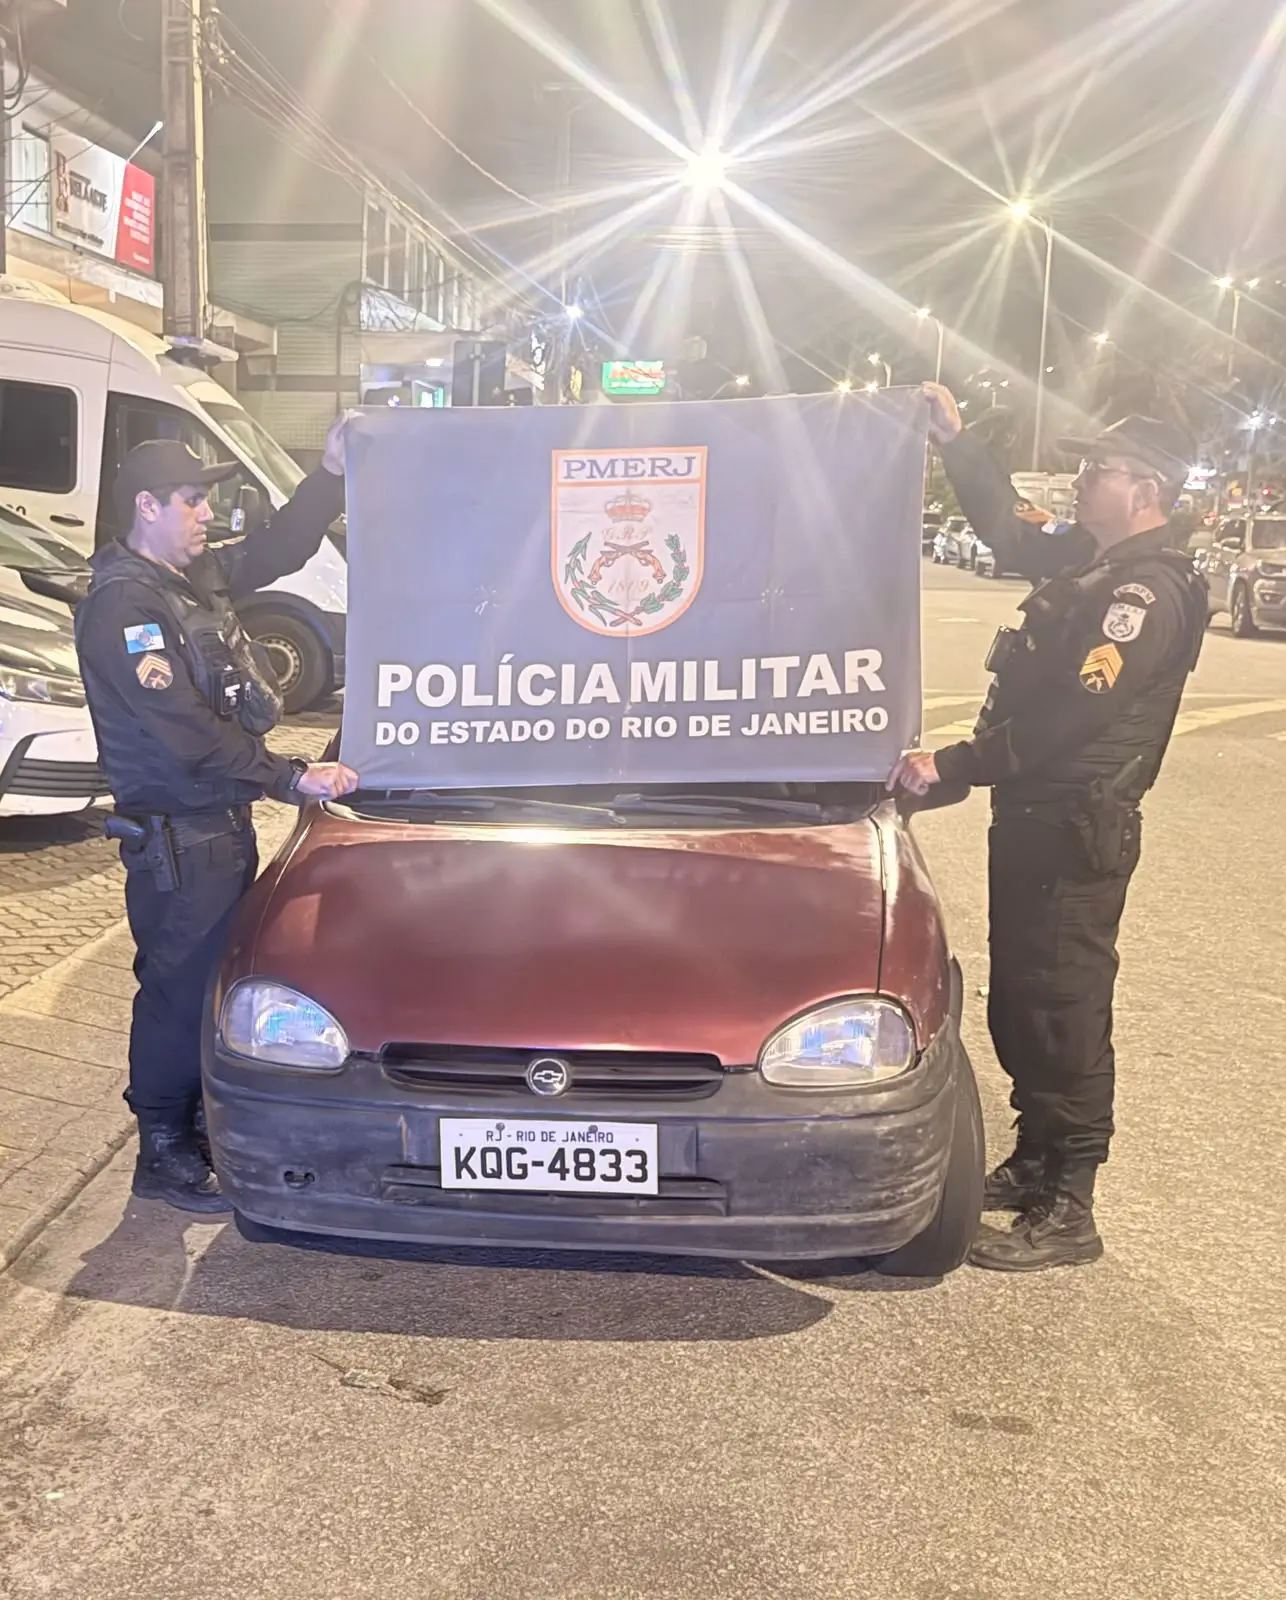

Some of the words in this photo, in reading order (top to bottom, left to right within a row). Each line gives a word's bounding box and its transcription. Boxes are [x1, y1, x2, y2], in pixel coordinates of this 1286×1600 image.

[563, 456, 697, 480] PMERJ
[377, 653, 621, 708] POLÍCIA
[630, 648, 886, 703] MILITAR
[375, 722, 420, 746] DO
[430, 718, 555, 745] ESTADO
[565, 717, 611, 741] DO
[621, 715, 678, 739] RIO
[688, 714, 731, 737] DE
[740, 707, 889, 736] JANEIRO
[486, 1130, 502, 1142] RJ
[516, 1130, 536, 1143] RIO
[541, 1130, 556, 1142] DE
[562, 1131, 614, 1144] JANEIRO
[454, 1147, 648, 1183] KQG-4833
